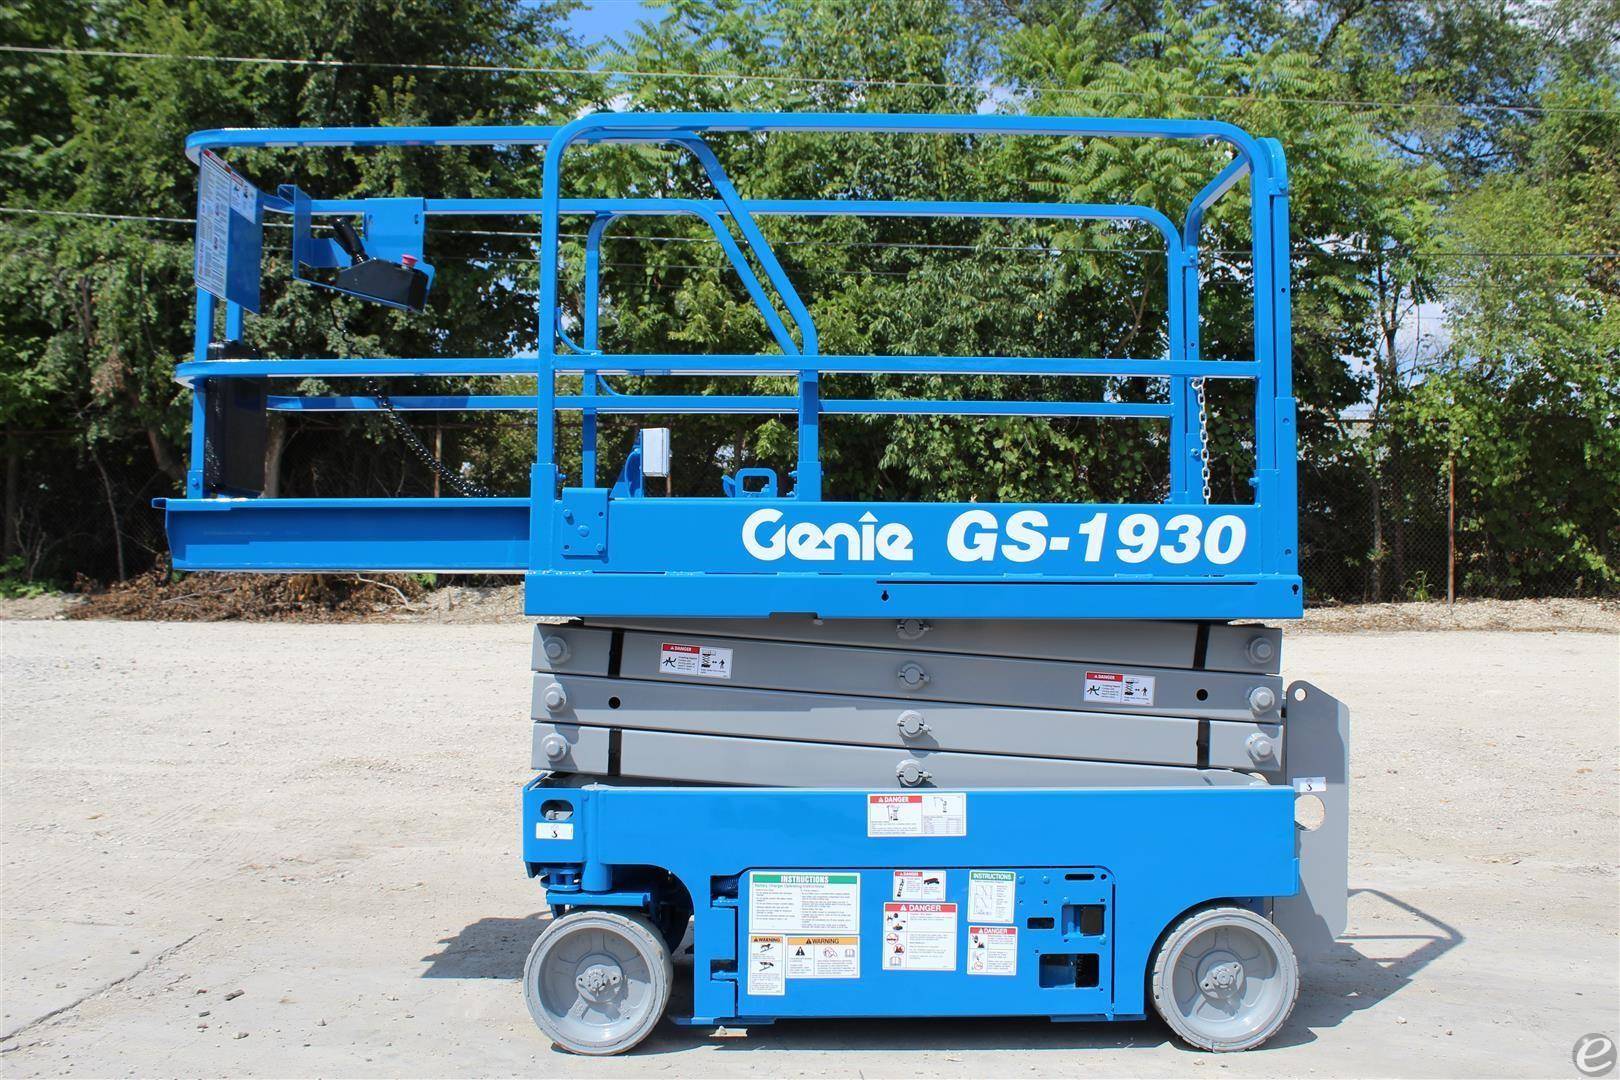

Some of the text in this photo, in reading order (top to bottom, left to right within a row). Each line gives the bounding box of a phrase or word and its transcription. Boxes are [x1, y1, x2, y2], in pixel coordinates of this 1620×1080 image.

[742, 508, 1247, 565] Genie GS-1930
[781, 875, 829, 884] INSTRUCTIONS
[909, 904, 942, 912] DANGER
[812, 937, 840, 945] WARNING
